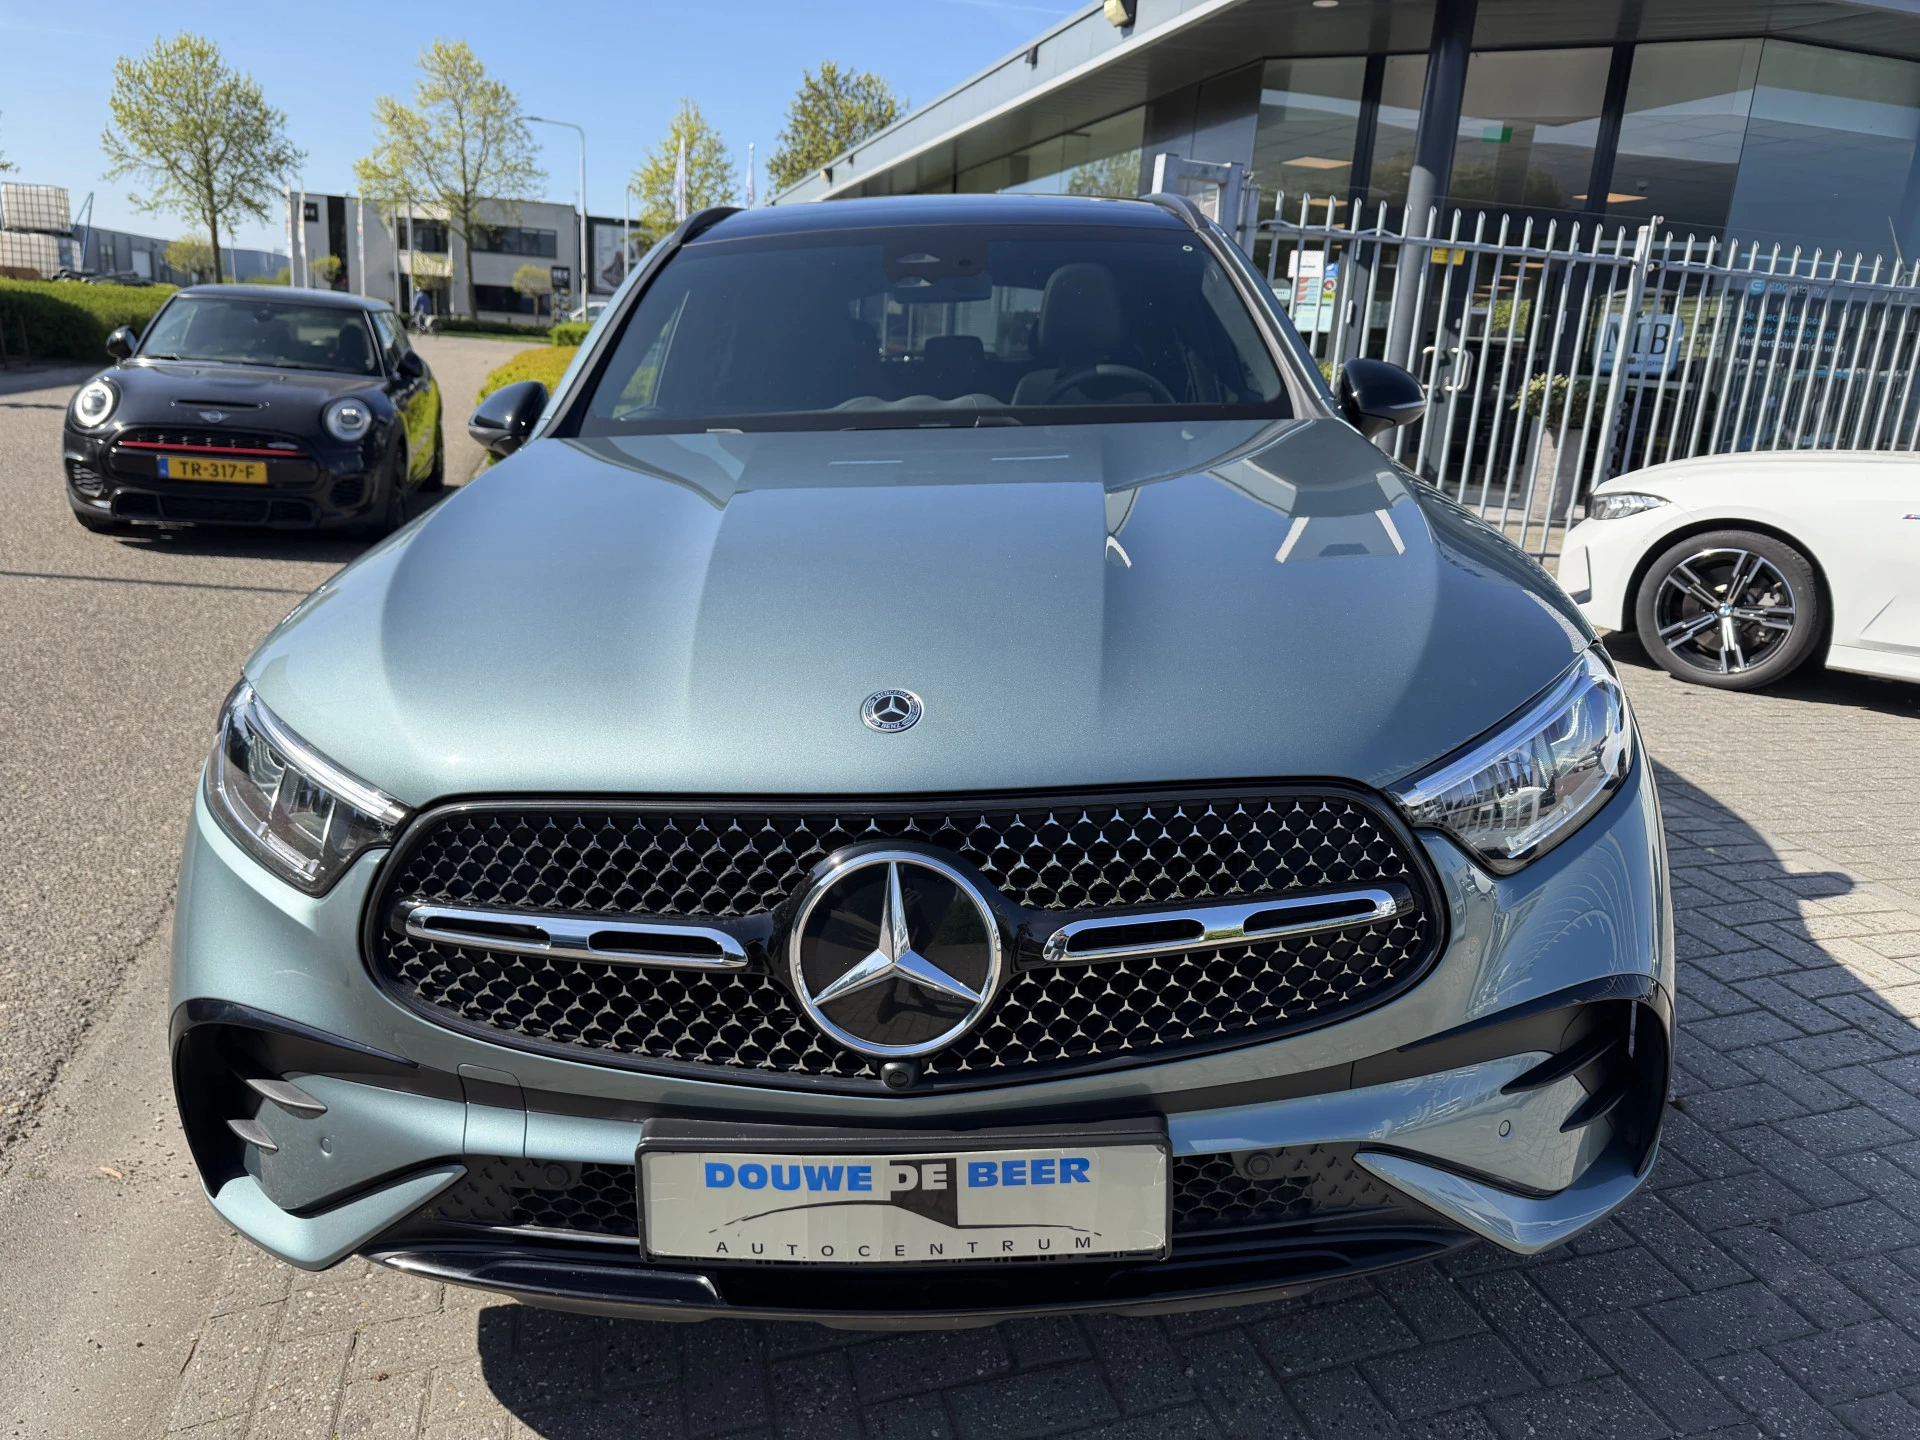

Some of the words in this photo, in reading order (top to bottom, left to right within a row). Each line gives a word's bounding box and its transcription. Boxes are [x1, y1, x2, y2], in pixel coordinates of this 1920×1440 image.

[179, 461, 255, 479] TR-317-F
[705, 1162, 873, 1192] DOUWE
[888, 1162, 949, 1192] DE
[967, 1157, 1091, 1188] BEER
[716, 1236, 1092, 1258] AUTOCENTRUM
